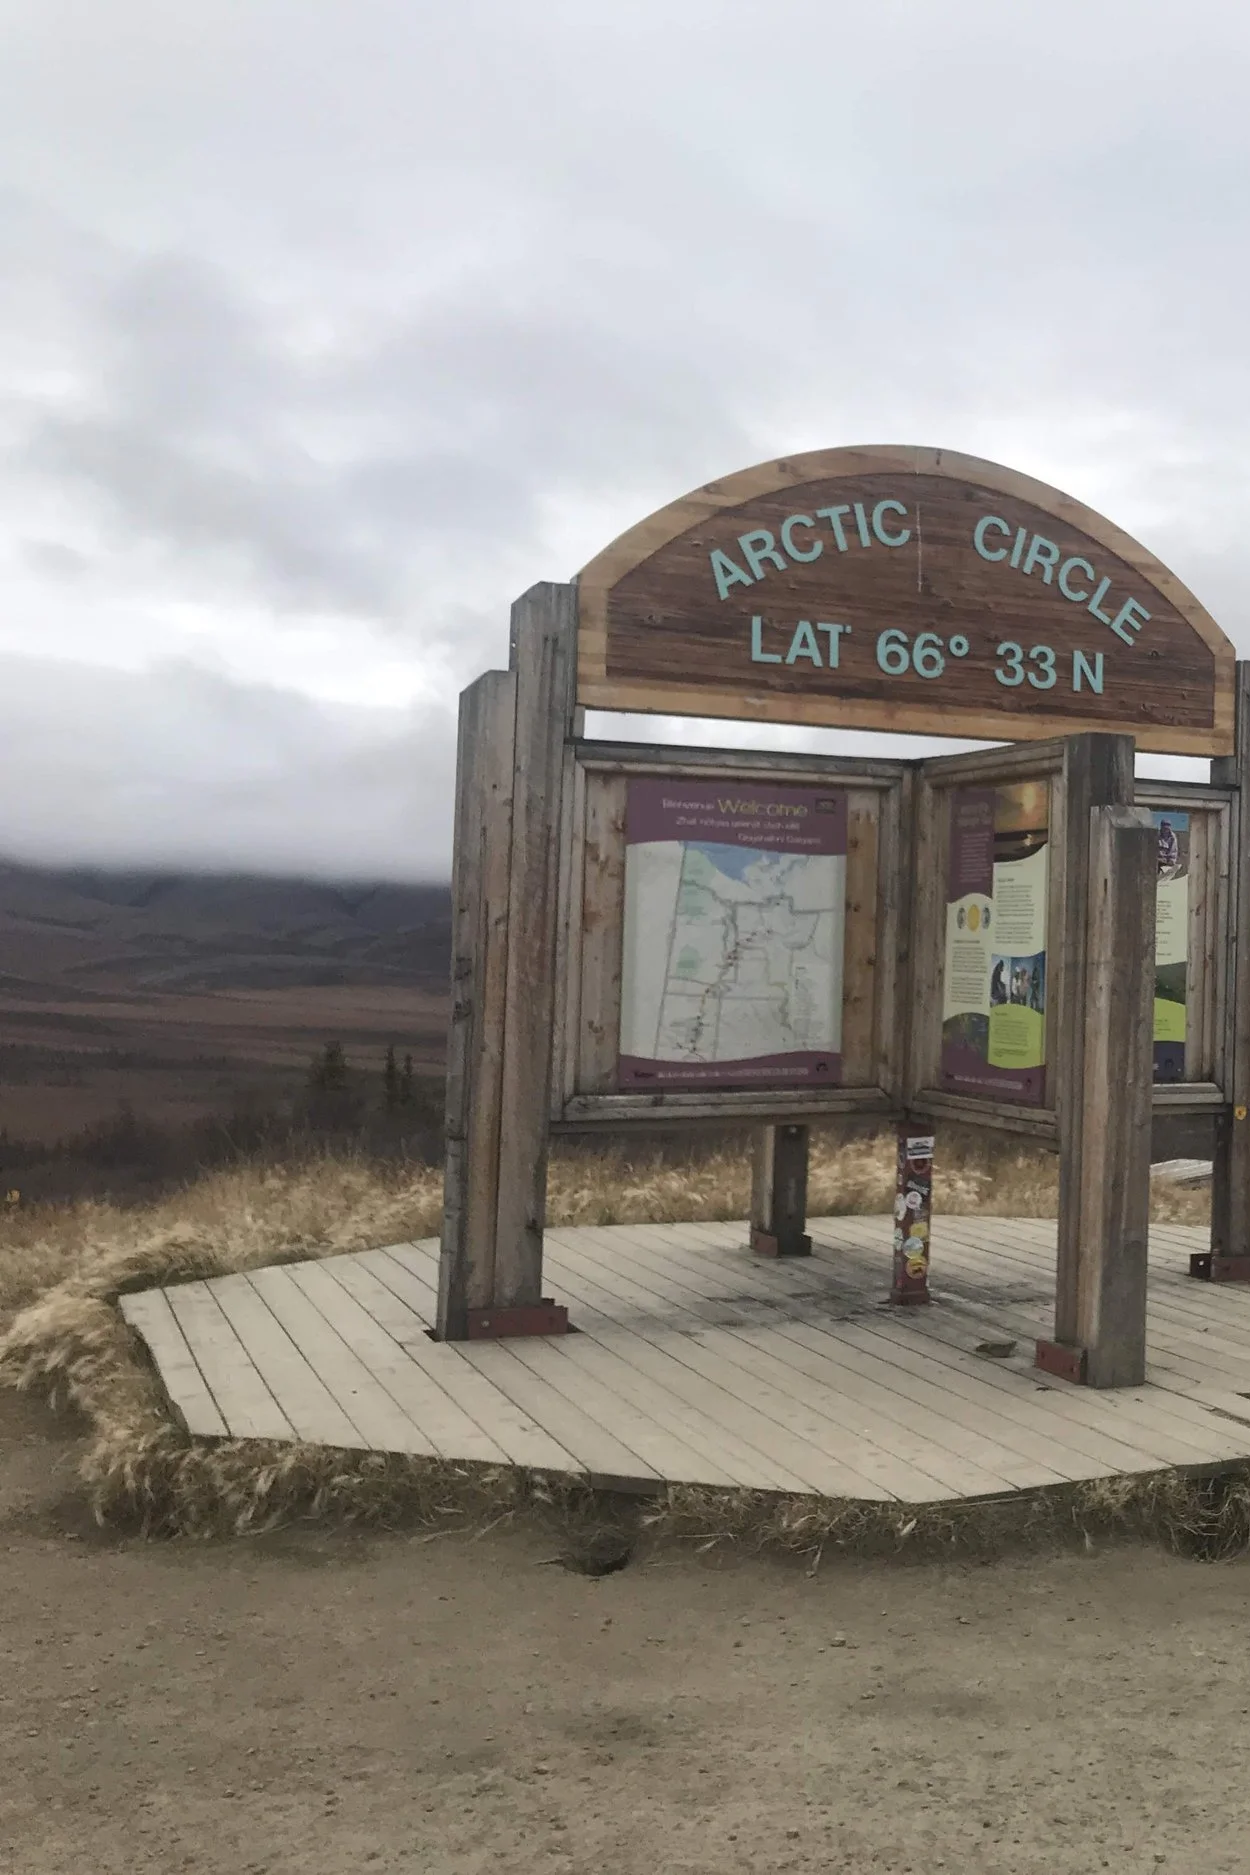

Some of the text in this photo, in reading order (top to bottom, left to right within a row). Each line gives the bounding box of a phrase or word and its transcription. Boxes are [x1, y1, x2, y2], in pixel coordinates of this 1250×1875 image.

[711, 500, 1151, 644] ARCTIC CIRCLE
[751, 616, 1104, 694] LAT 66° 33 N
[717, 798, 808, 818] Welcome
